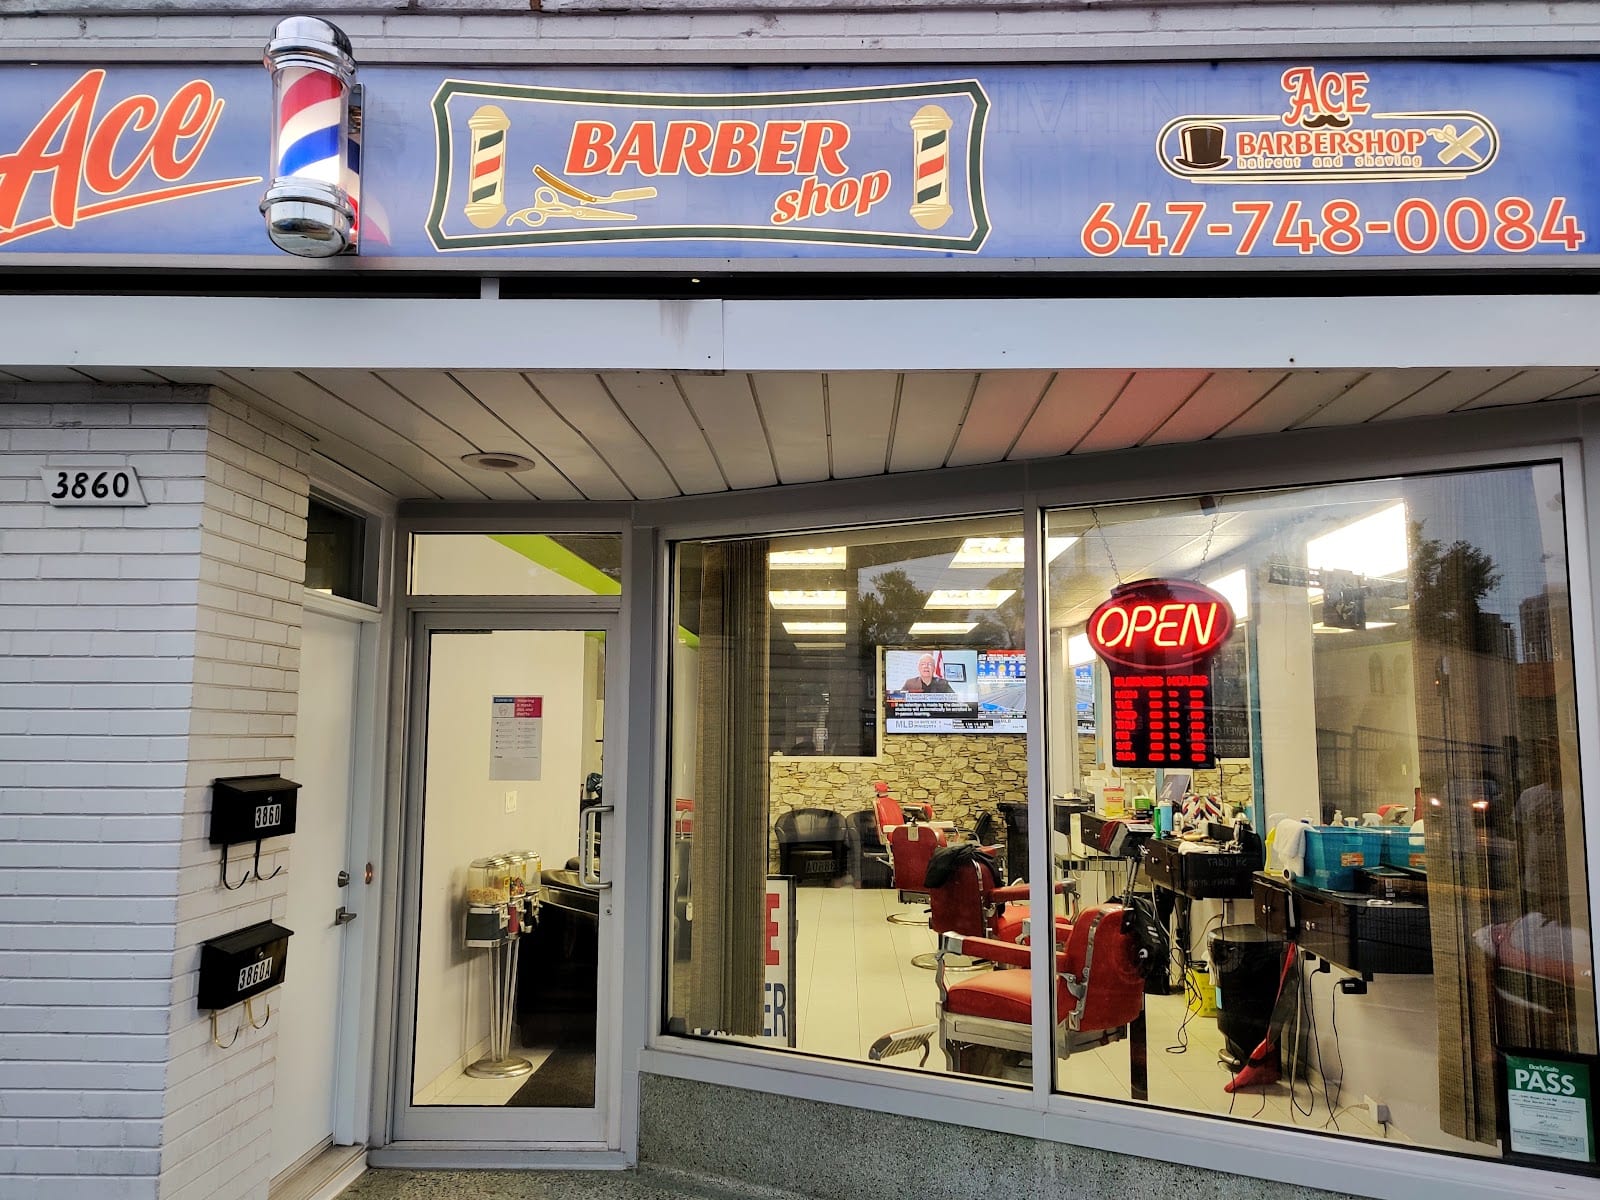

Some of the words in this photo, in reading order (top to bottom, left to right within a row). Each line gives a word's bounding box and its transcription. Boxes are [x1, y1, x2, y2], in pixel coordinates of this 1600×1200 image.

[1281, 65, 1371, 127] ACE
[0, 68, 226, 231] Ace
[563, 119, 851, 177] BARBER
[1236, 129, 1427, 157] BARBERSHOP
[1237, 155, 1302, 169] haircut
[1312, 155, 1344, 168] and
[1354, 154, 1423, 169] shaving
[770, 168, 892, 226] shop
[1080, 196, 1585, 257] 647-748-0084
[51, 471, 129, 499] 3860
[1096, 602, 1218, 648] OPEN
[255, 804, 281, 827] 3860
[238, 958, 272, 990] 3860A
[1515, 1068, 1576, 1096] PASS
